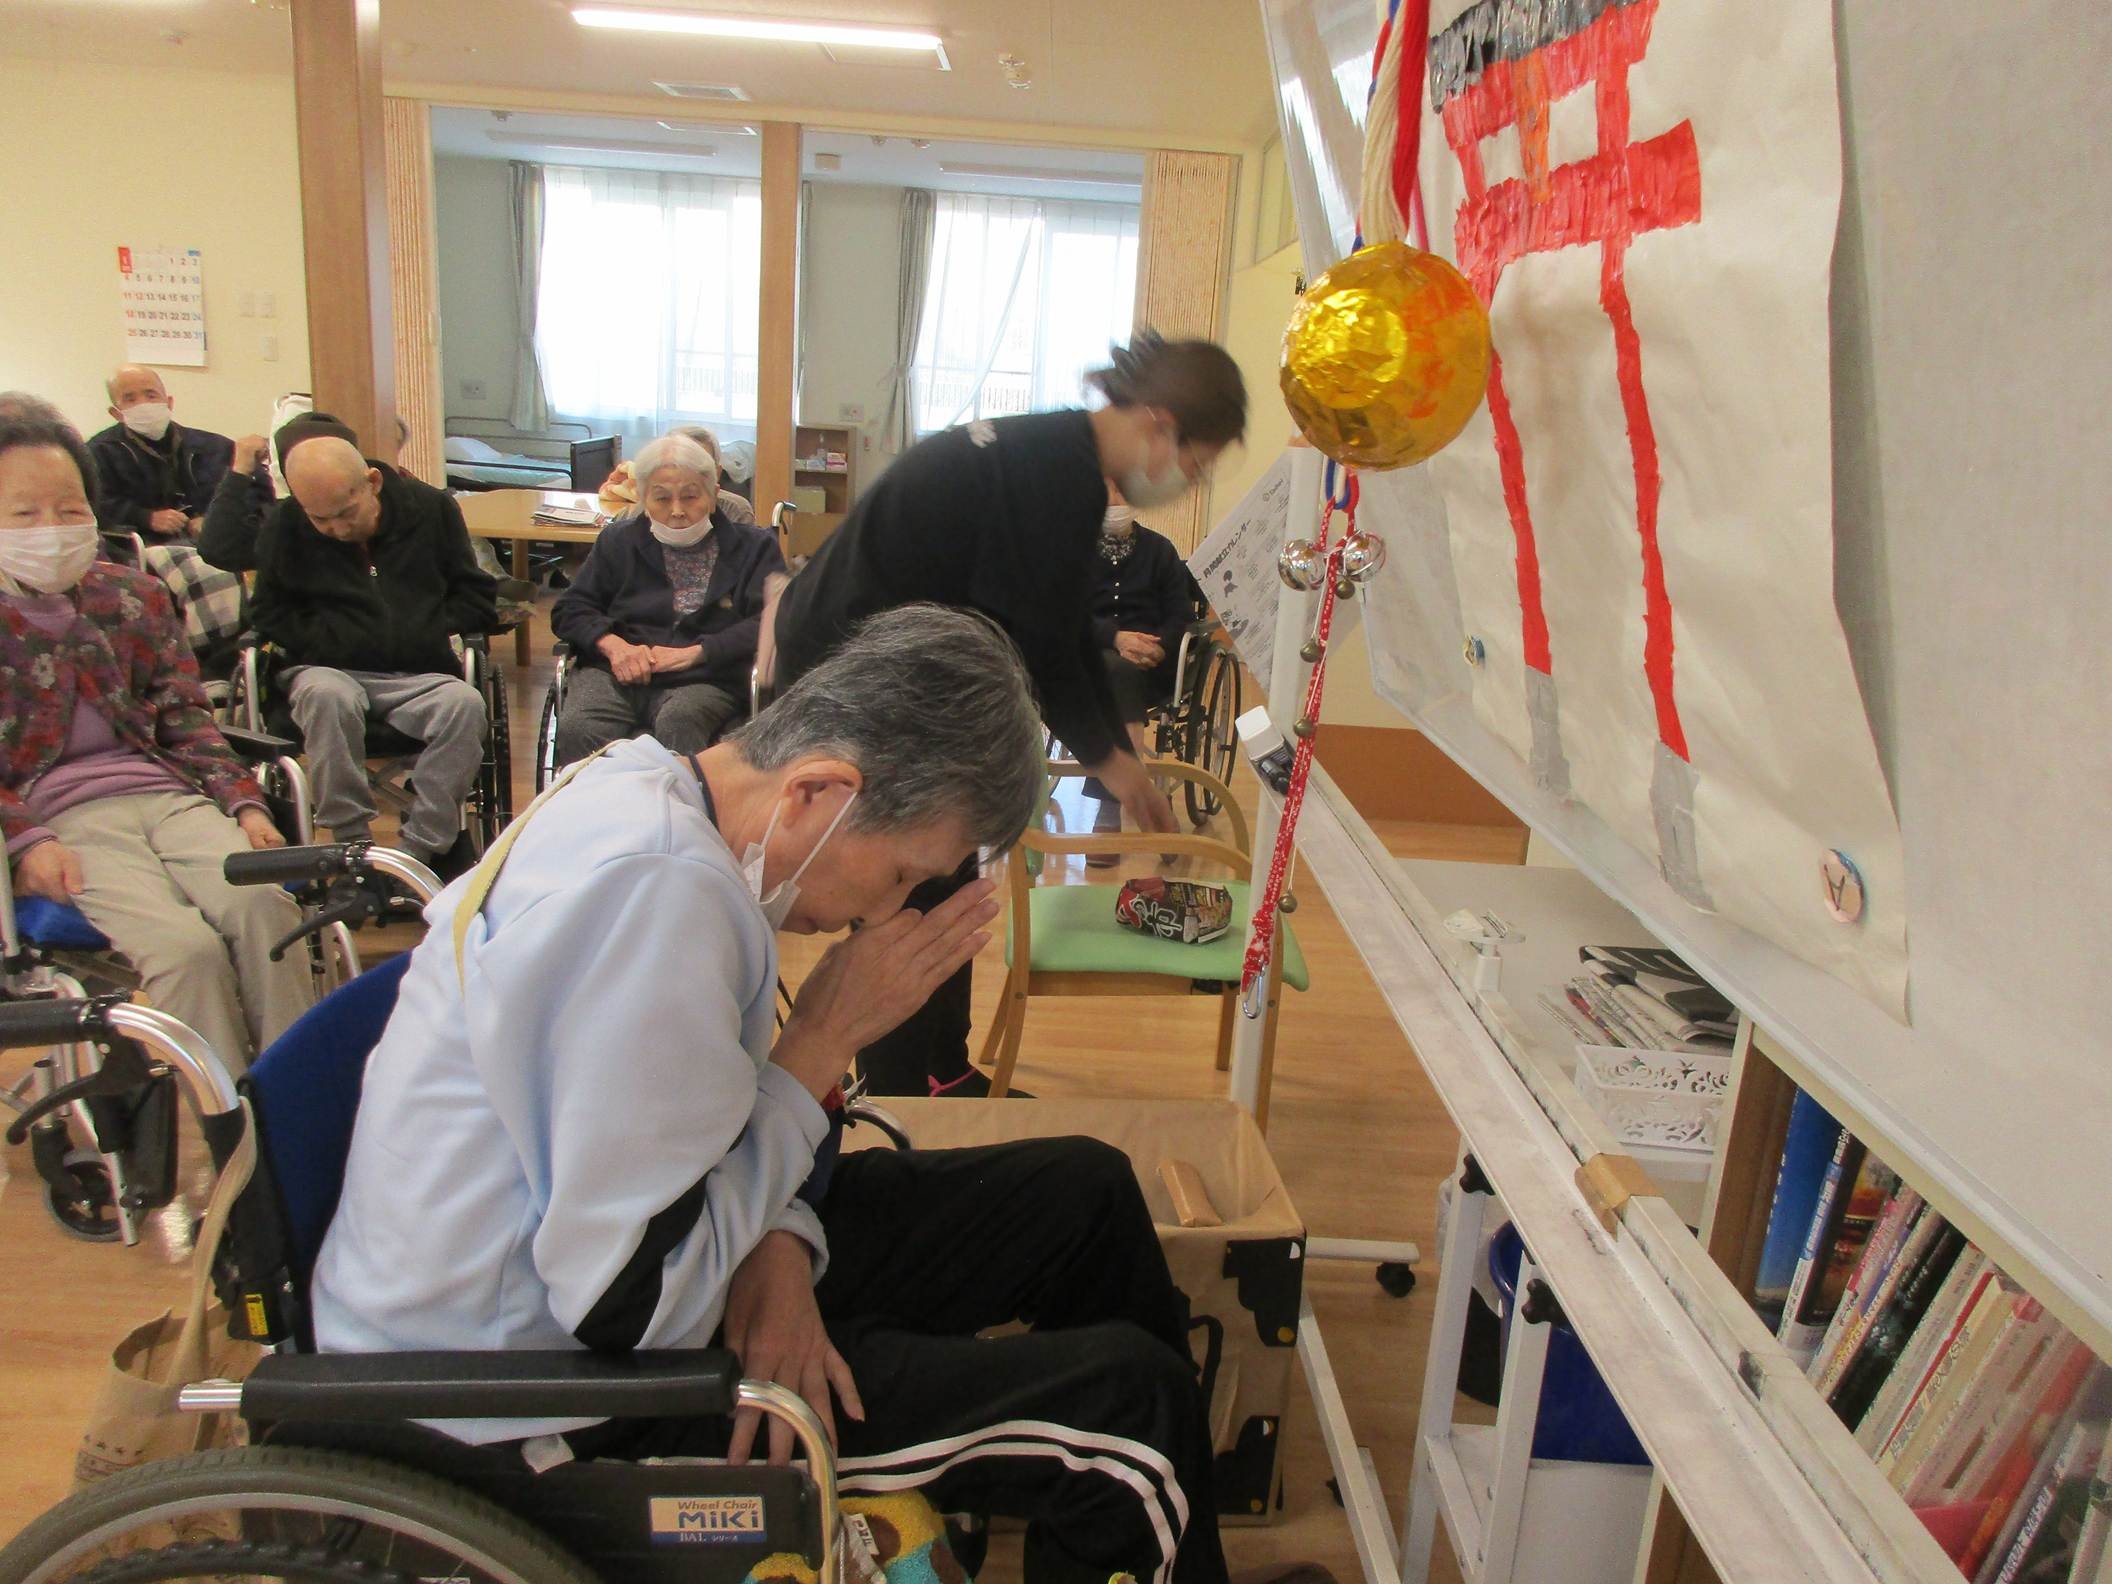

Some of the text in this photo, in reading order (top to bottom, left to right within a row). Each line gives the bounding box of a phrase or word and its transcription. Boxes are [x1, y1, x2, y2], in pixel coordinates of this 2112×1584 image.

[125, 292, 132, 300] 11
[136, 293, 144, 301] 12
[147, 293, 155, 301] 13
[170, 294, 177, 302] 15
[181, 294, 189, 302] 16
[126, 310, 134, 318] 18
[138, 311, 146, 319] 19
[149, 311, 157, 320] 20
[160, 312, 168, 320] 21
[171, 312, 179, 321] 22
[182, 313, 190, 321] 23
[128, 329, 136, 337] 25
[139, 329, 147, 337] 26
[150, 330, 158, 338] 27
[161, 330, 170, 338] 28
[173, 331, 181, 339] 29
[184, 331, 192, 339] 30
[678, 1500, 758, 1509] Wheel Chair
[678, 1511, 759, 1528] MiKi
